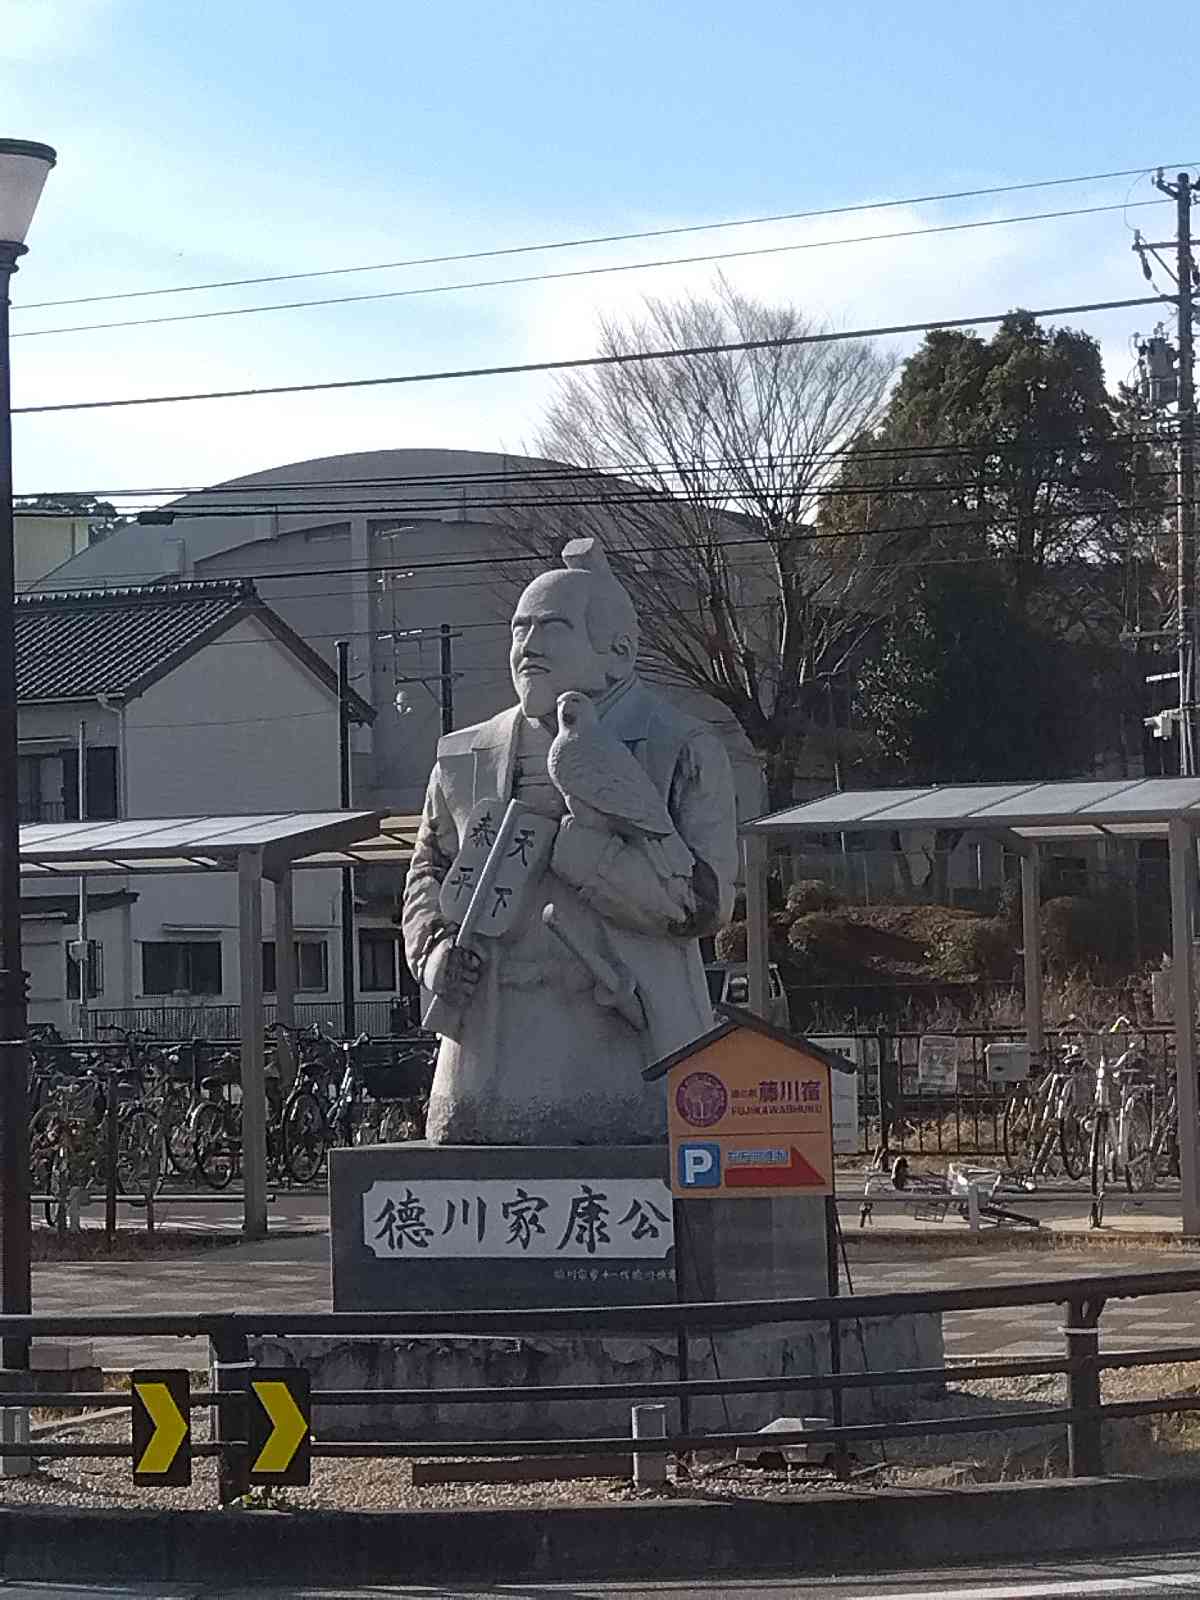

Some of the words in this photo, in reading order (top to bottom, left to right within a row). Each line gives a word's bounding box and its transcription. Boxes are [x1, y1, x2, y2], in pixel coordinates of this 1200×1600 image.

[450, 811, 496, 902] 泰平
[491, 828, 536, 918] 天下
[758, 1080, 821, 1103] 藤川宿
[684, 1149, 712, 1183] P
